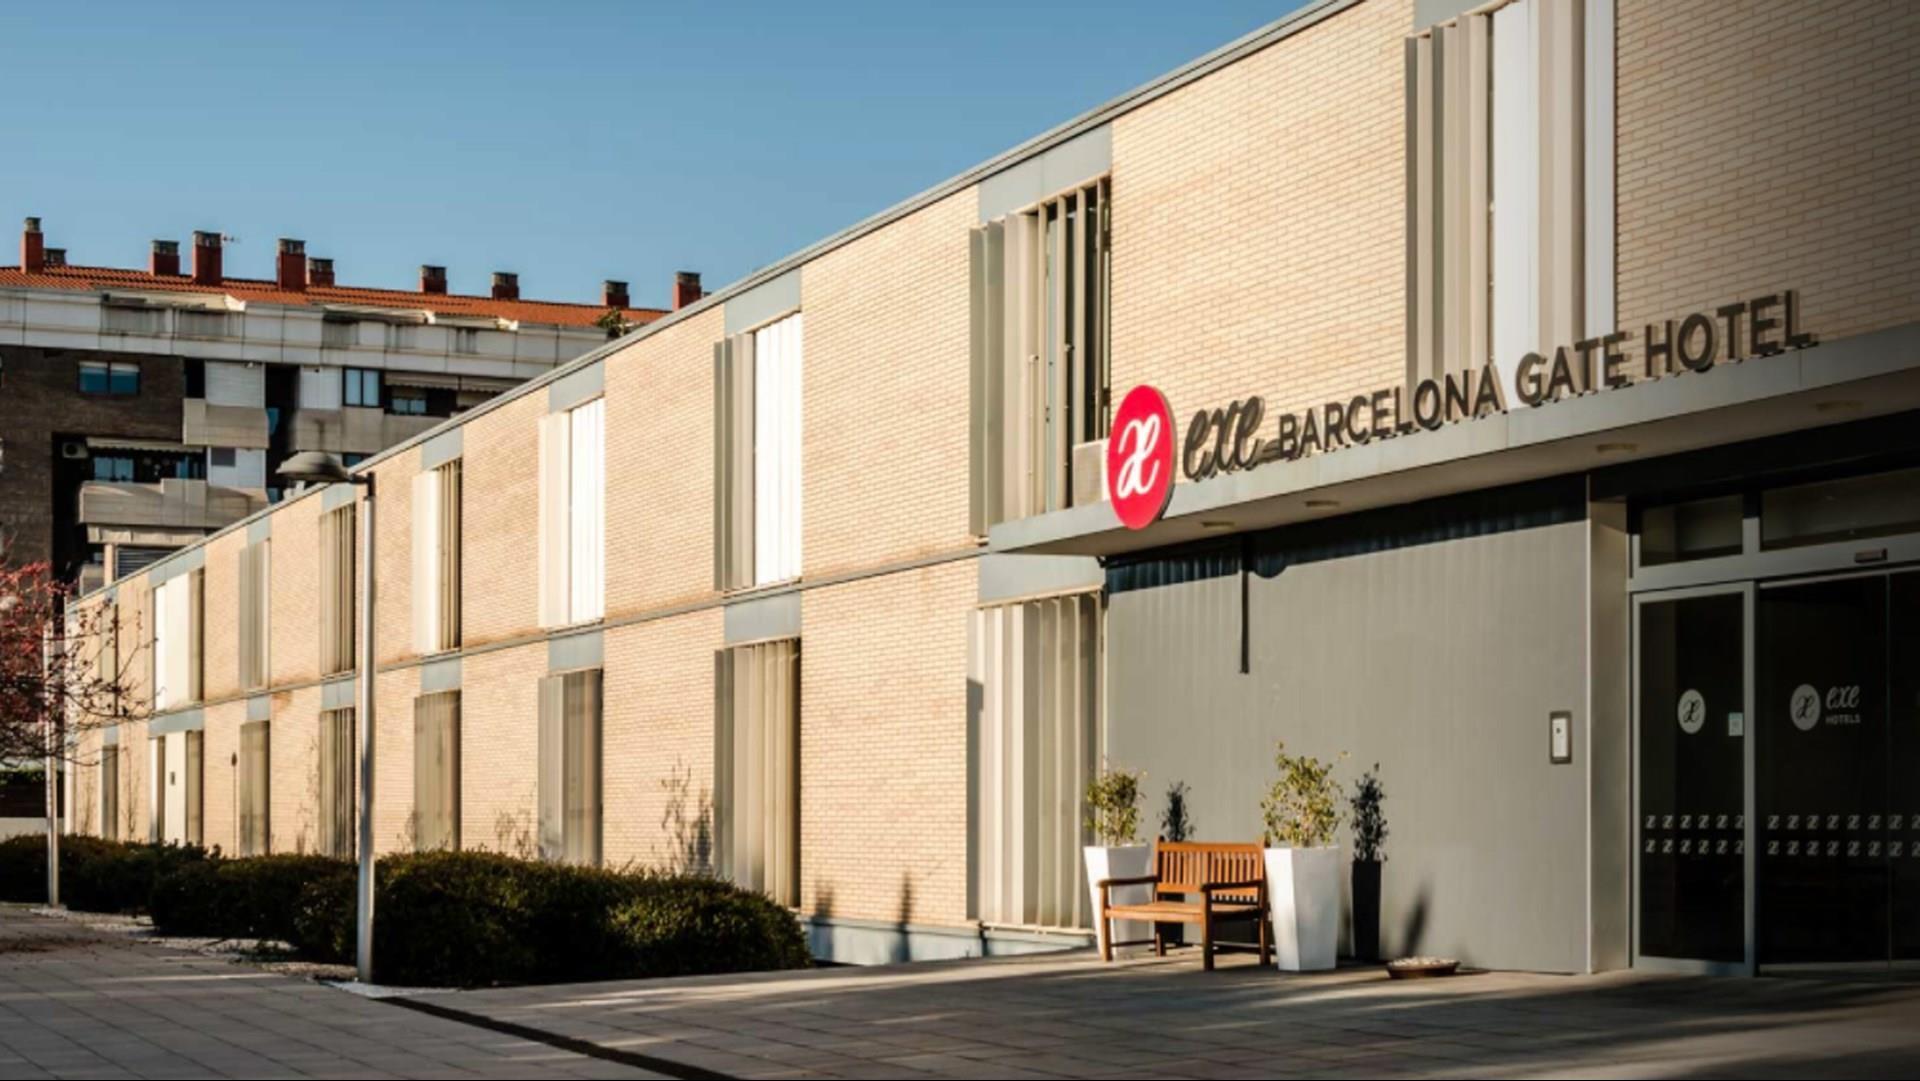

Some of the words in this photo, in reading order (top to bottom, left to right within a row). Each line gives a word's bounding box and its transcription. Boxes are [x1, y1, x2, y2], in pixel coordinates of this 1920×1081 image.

[1182, 395, 1265, 482] exe
[1278, 363, 1505, 460] BARCELONA
[1515, 330, 1630, 408] GATE
[1644, 289, 1815, 373] HOTEL
